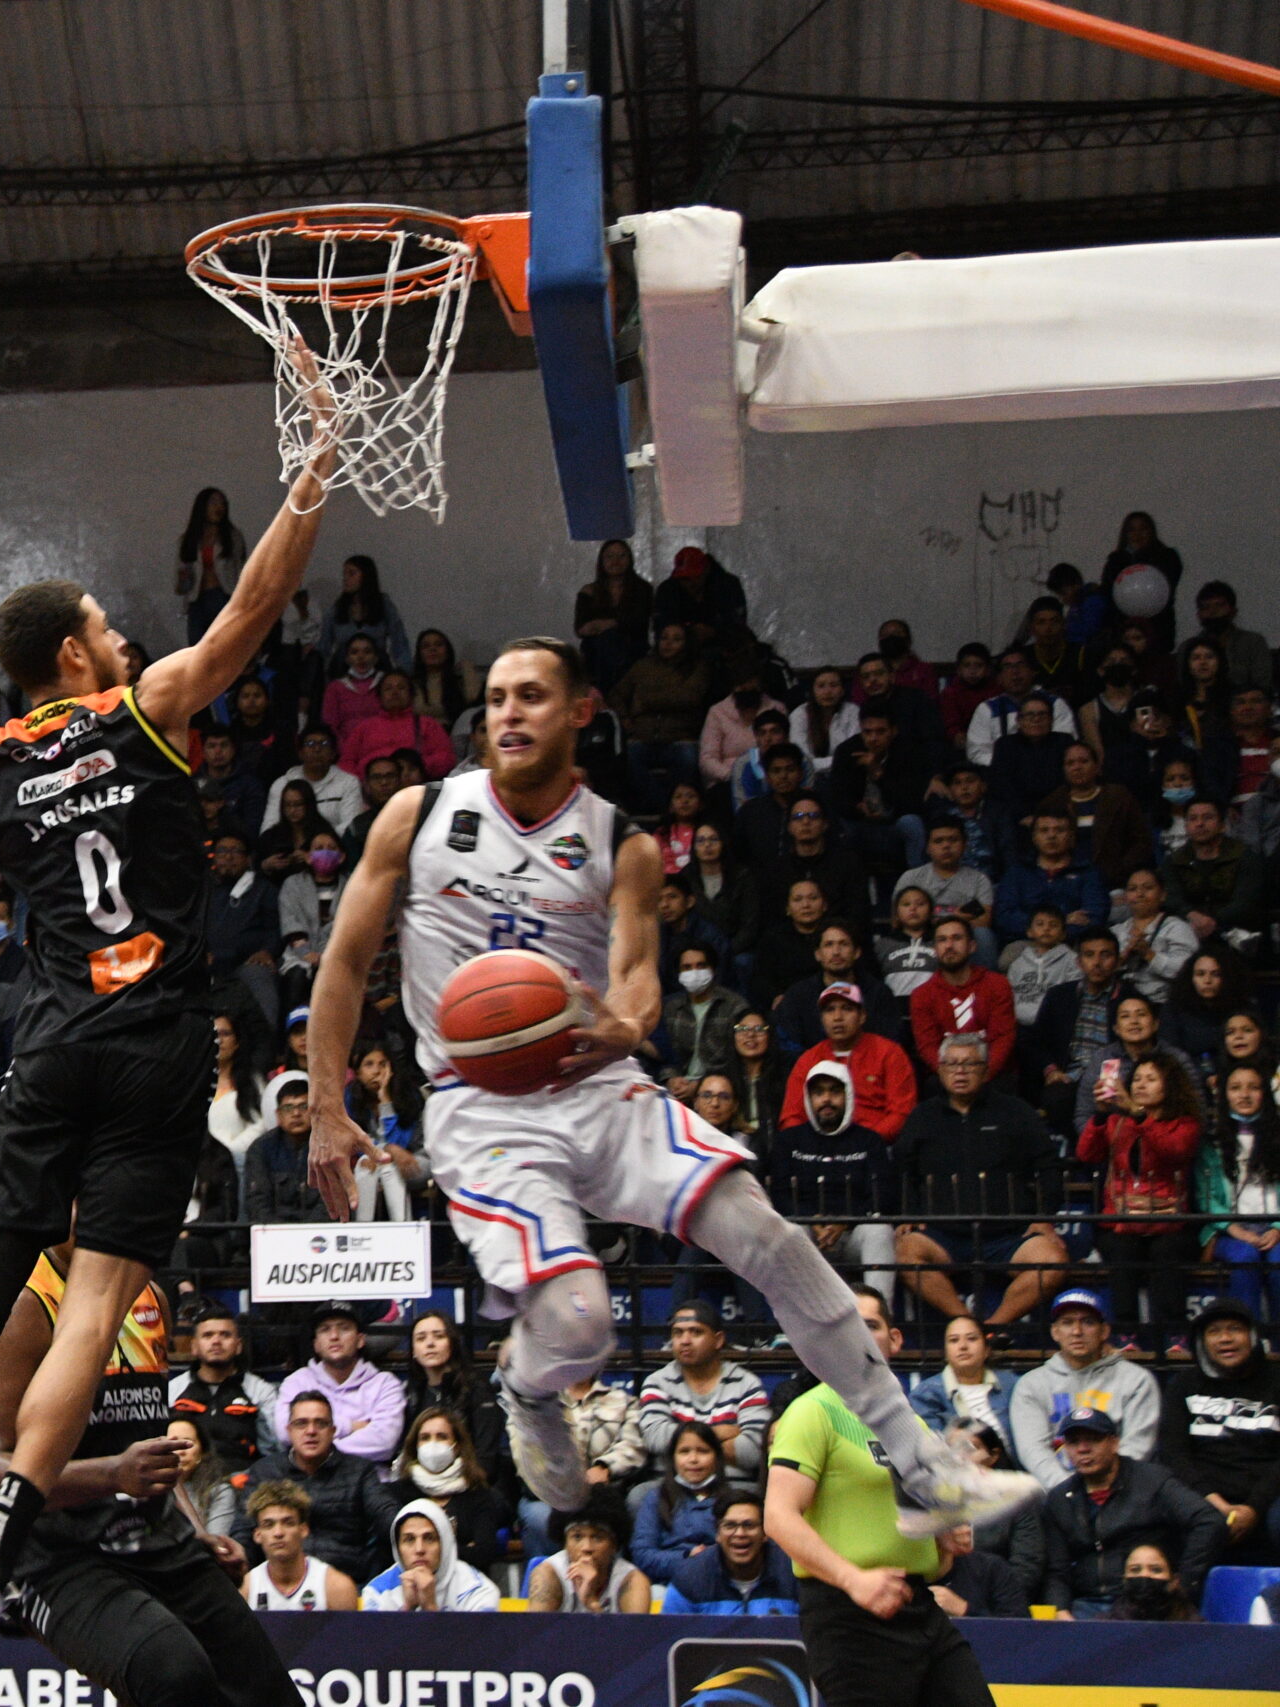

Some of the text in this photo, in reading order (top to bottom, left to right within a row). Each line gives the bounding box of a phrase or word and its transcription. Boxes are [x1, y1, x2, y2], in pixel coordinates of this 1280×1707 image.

[75, 830, 134, 934] 0
[489, 912, 547, 953] 22
[267, 1260, 415, 1285] AUSPICIANTES
[103, 1387, 161, 1406] ALFONSO
